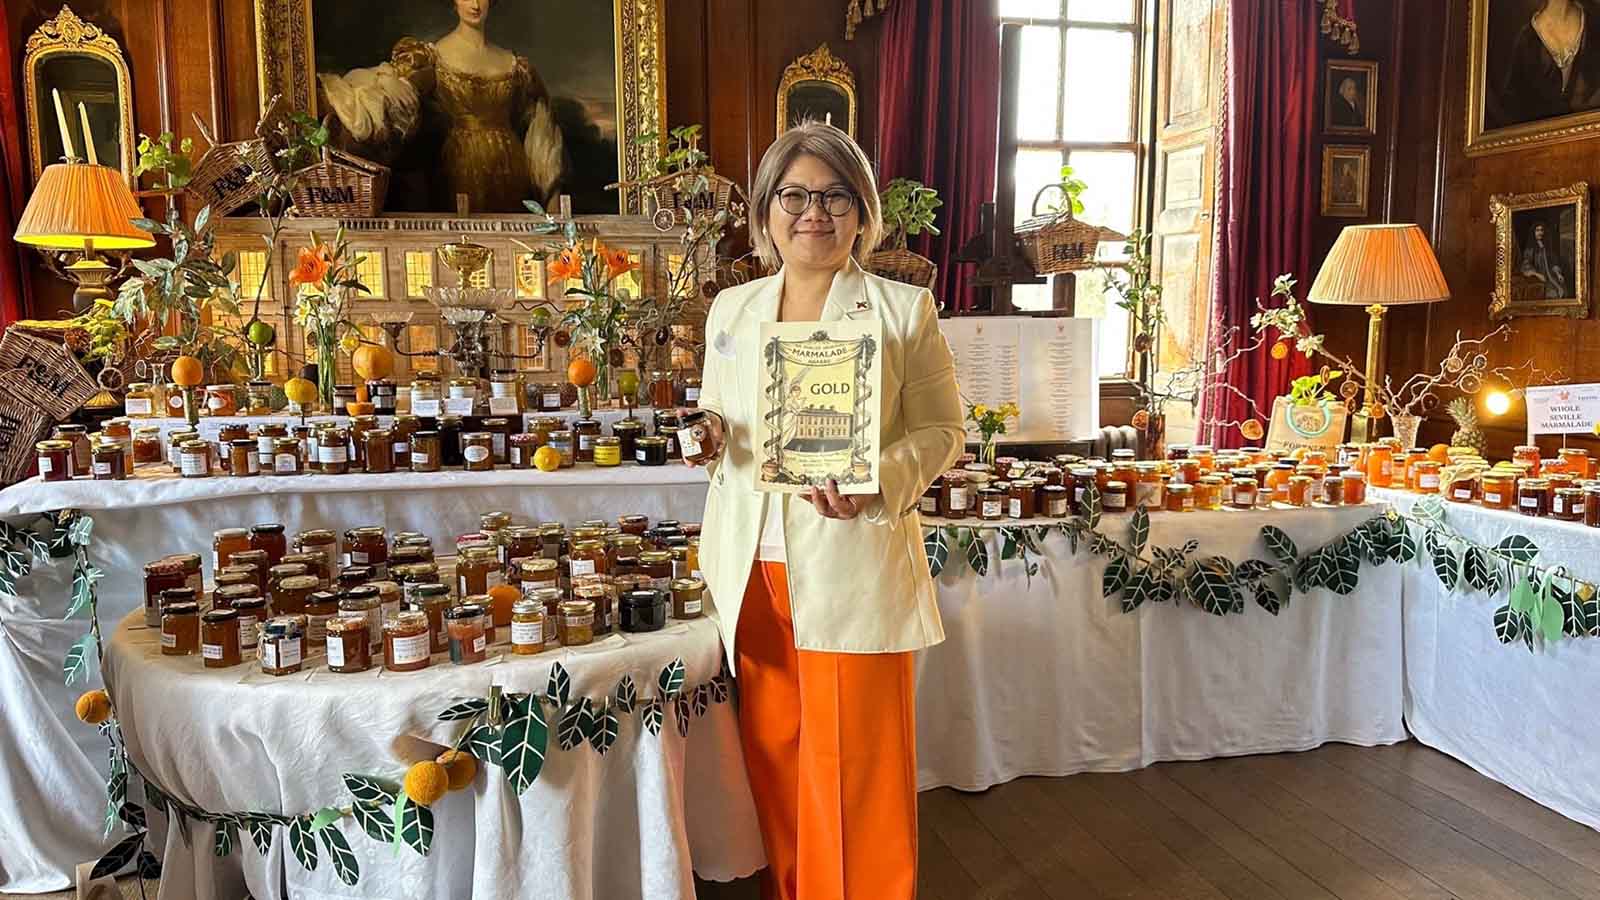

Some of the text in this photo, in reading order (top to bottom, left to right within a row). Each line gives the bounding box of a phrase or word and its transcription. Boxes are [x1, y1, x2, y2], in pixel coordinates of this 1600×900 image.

[305, 186, 355, 204] F&M
[791, 346, 849, 358] MARMALADE
[810, 383, 850, 395] GOLD
[1550, 405, 1581, 413] WHOLE
[1550, 413, 1582, 421] SEVILLE
[1541, 420, 1593, 429] MARMALADE
